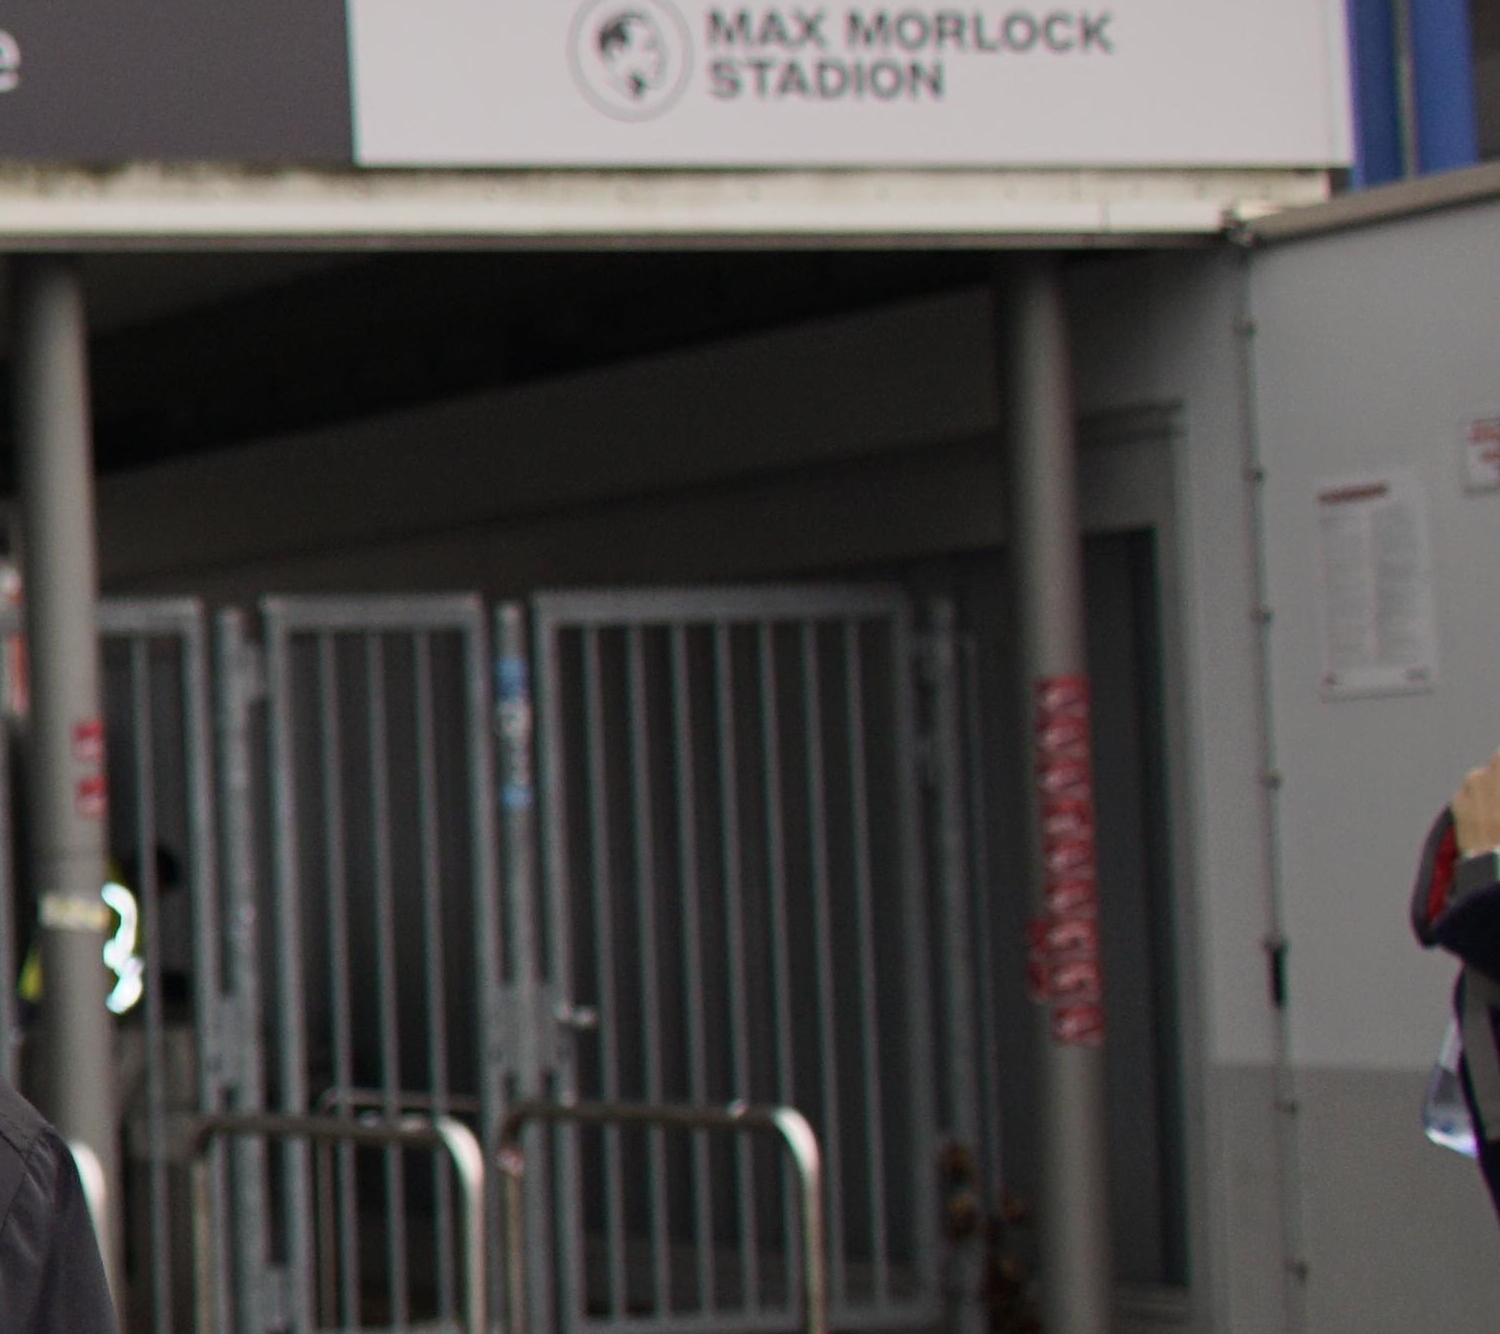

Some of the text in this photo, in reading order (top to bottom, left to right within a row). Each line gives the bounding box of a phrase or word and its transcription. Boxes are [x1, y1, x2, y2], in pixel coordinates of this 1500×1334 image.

[706, 6, 1116, 55] MAX MORLOCK
[707, 57, 946, 102] STADION
